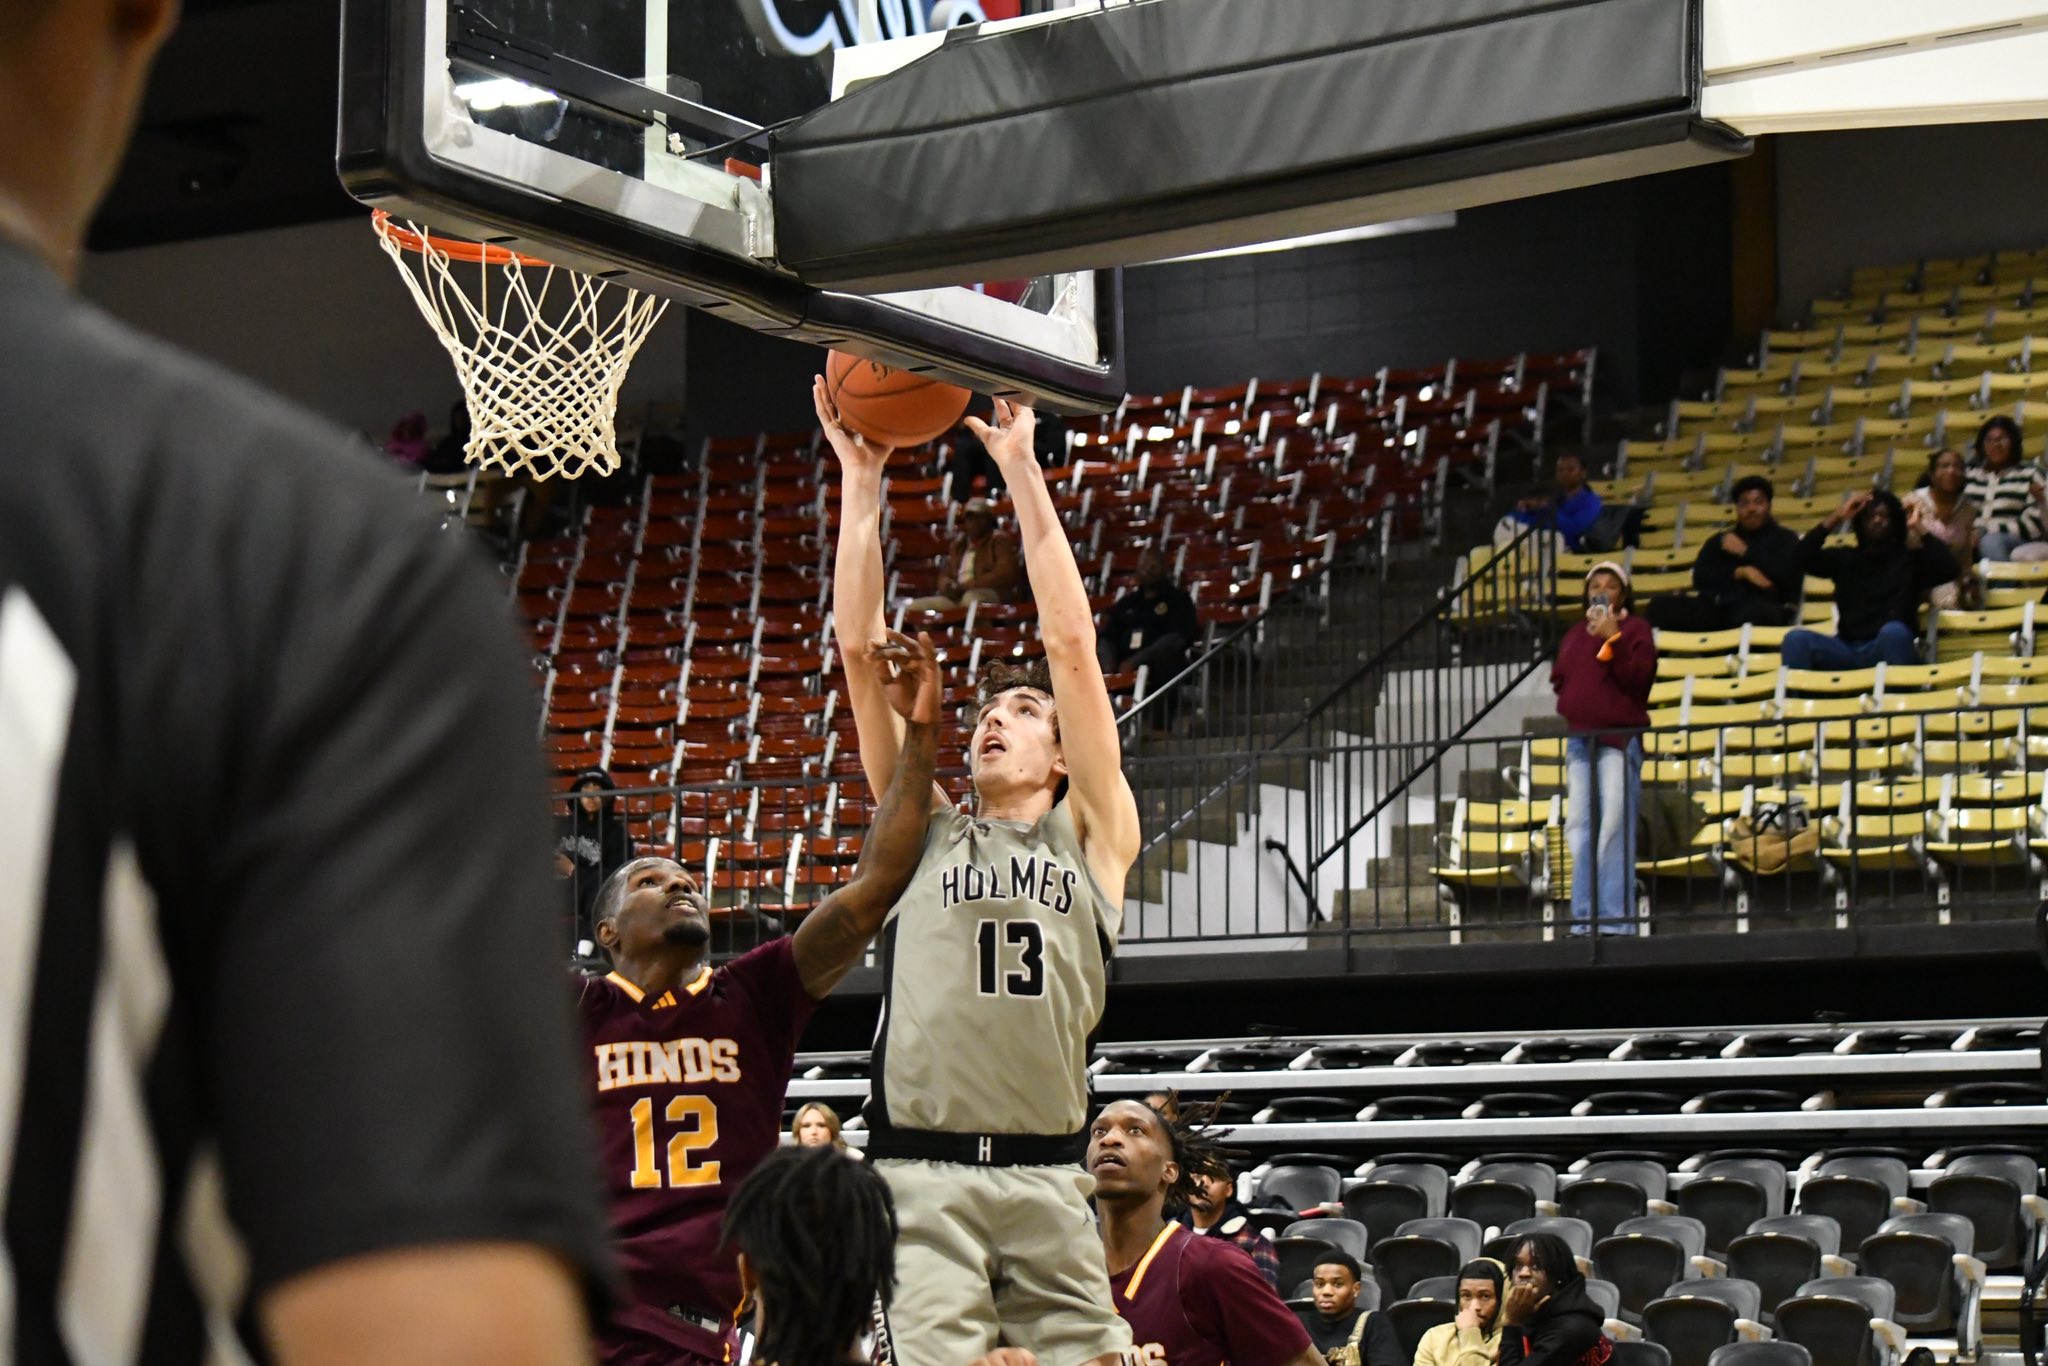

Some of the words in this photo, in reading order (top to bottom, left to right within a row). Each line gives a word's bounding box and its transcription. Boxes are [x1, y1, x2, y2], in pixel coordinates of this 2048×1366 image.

[942, 854, 1077, 917] HOLMES
[974, 918, 1046, 1000] 13
[594, 1037, 742, 1092] HINDS
[630, 1094, 721, 1189] 12
[979, 1136, 992, 1162] H
